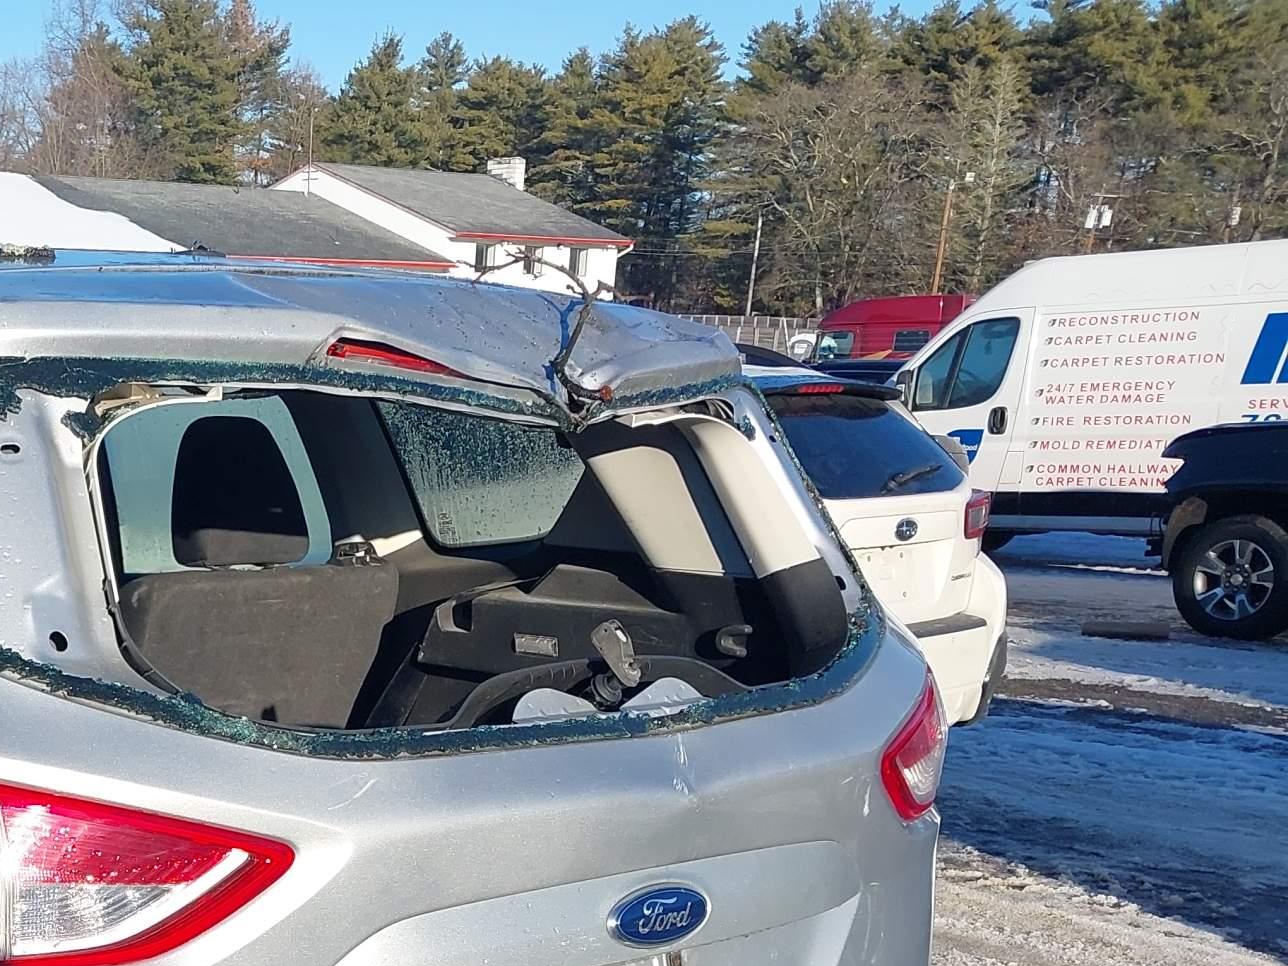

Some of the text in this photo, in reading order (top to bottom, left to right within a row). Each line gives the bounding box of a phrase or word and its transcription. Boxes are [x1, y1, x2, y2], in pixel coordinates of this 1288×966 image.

[1057, 311, 1201, 328] RECONSTRUCTION
[1053, 331, 1198, 346] CARPET CLEANING
[1050, 353, 1225, 368] CARPET RESTORATION
[1046, 380, 1176, 393] 24/7 EMERGENCY
[1045, 393, 1166, 405] WATER DAMAGE
[1041, 414, 1192, 426] FIRE RESTORATION
[1039, 439, 1168, 450] MOLD REMEDIATI
[1036, 463, 1179, 474] COMMON HALLWAY
[1035, 477, 1165, 487] CARPET CLEANIN
[638, 896, 692, 934] Ford
